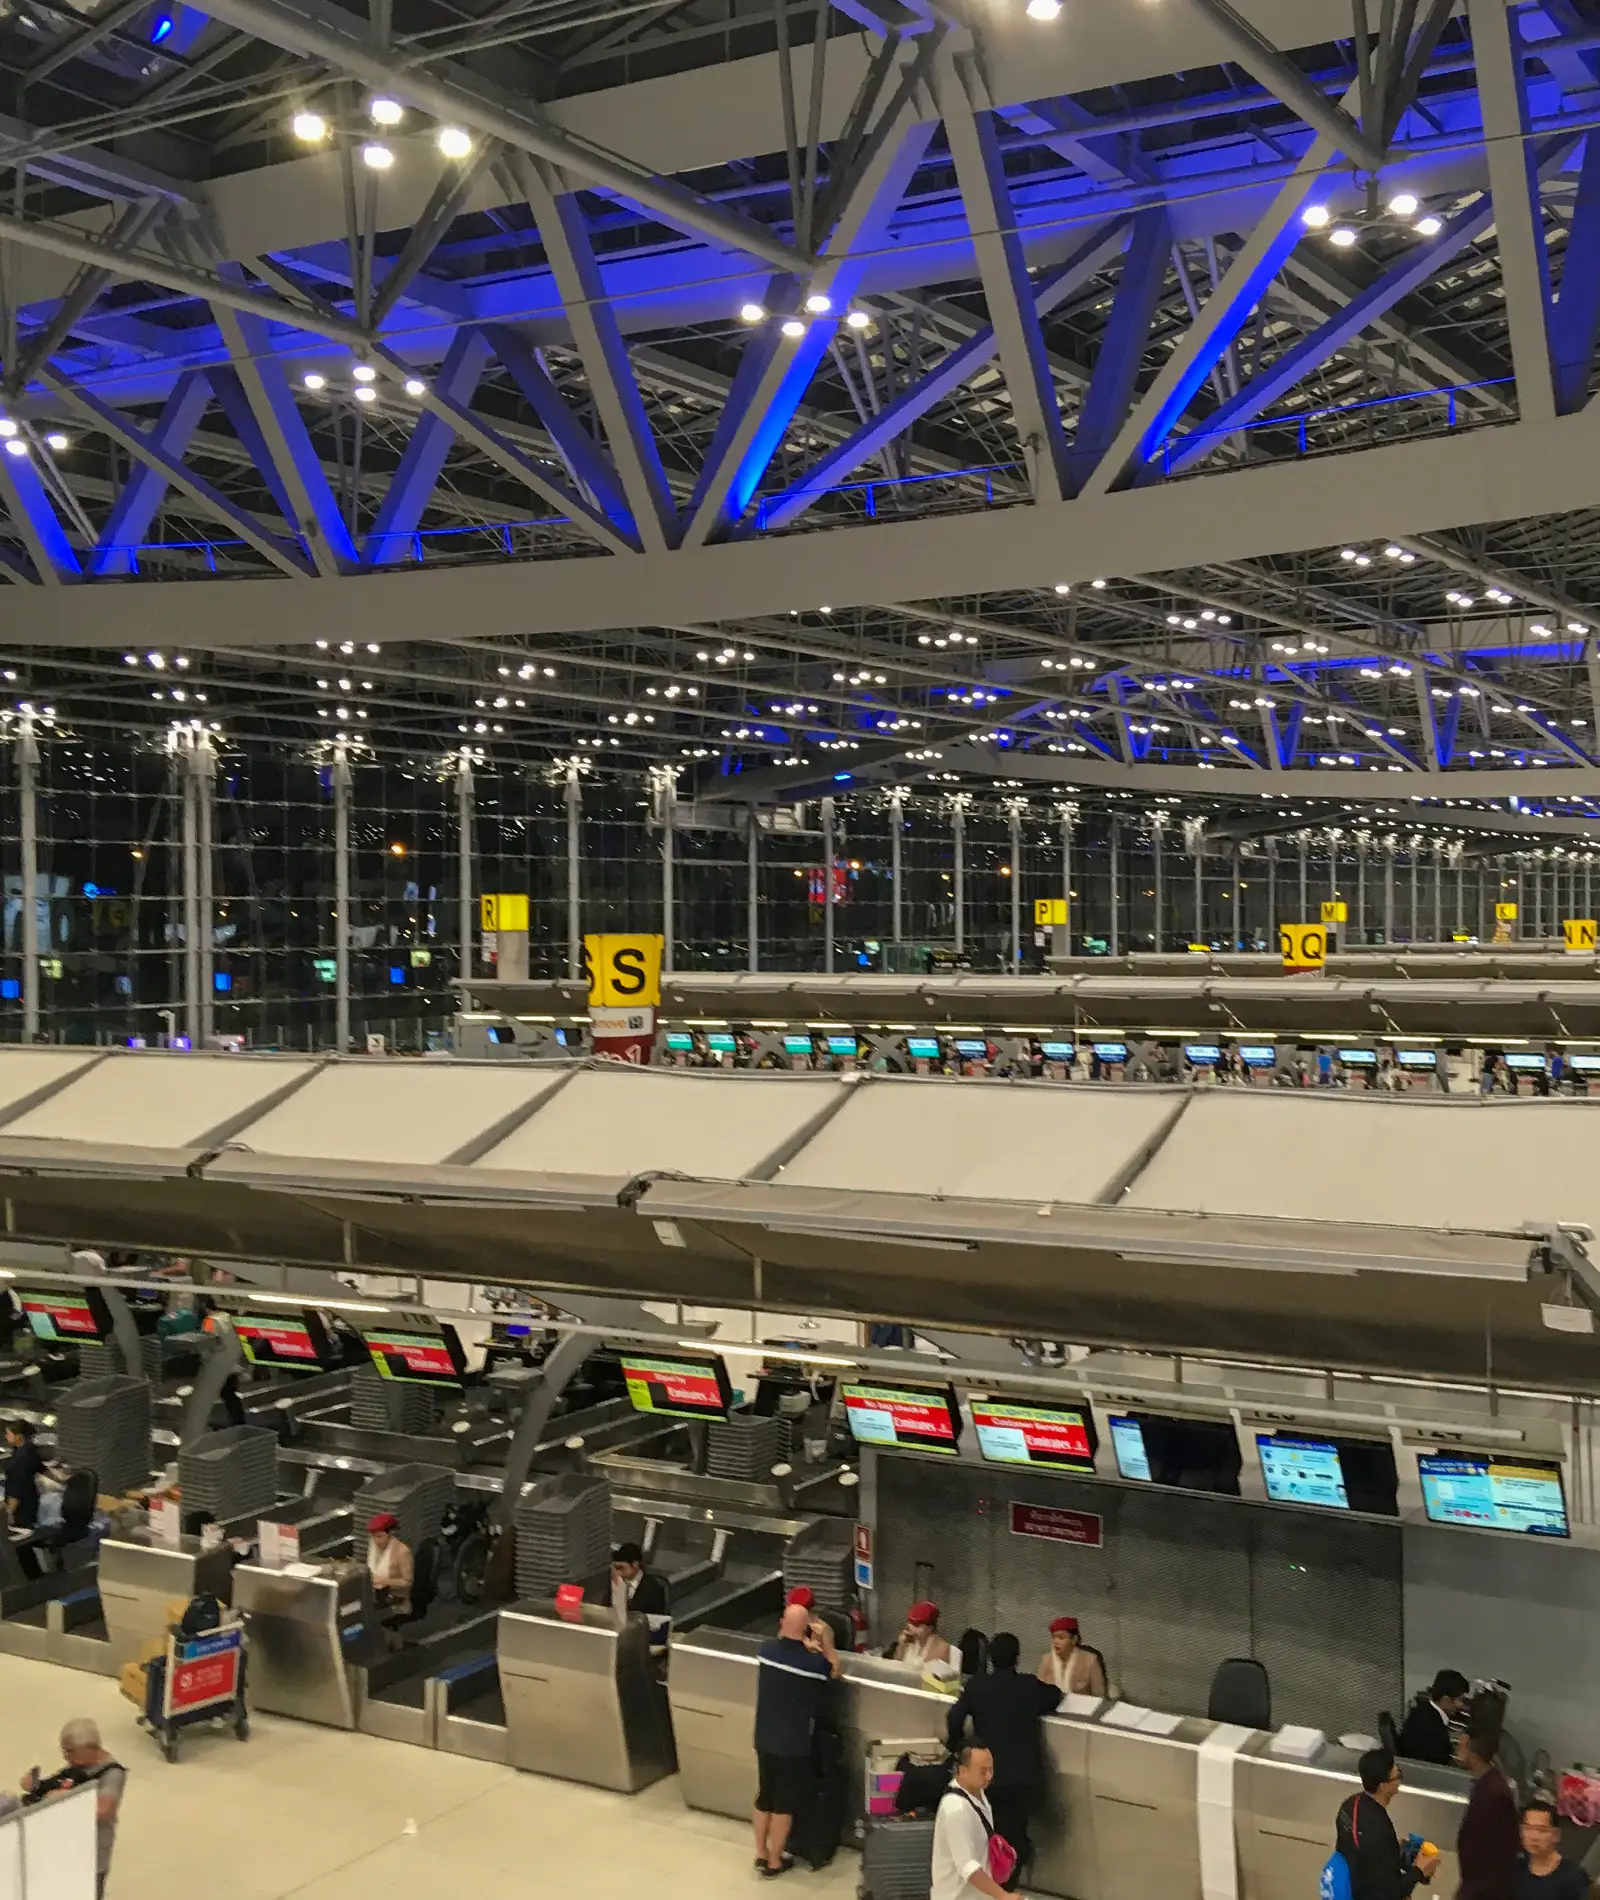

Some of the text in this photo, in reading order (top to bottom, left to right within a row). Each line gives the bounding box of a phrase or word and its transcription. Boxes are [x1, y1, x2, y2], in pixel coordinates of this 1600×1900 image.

[486, 898, 495, 927] R
[1039, 903, 1048, 922] P
[1580, 924, 1595, 945] N
[1301, 932, 1323, 960] Q
[611, 948, 646, 995] S
[894, 1416, 937, 1432] Emirates
[991, 1416, 1069, 1434] Customer Service
[1025, 1434, 1072, 1450] Emirates
